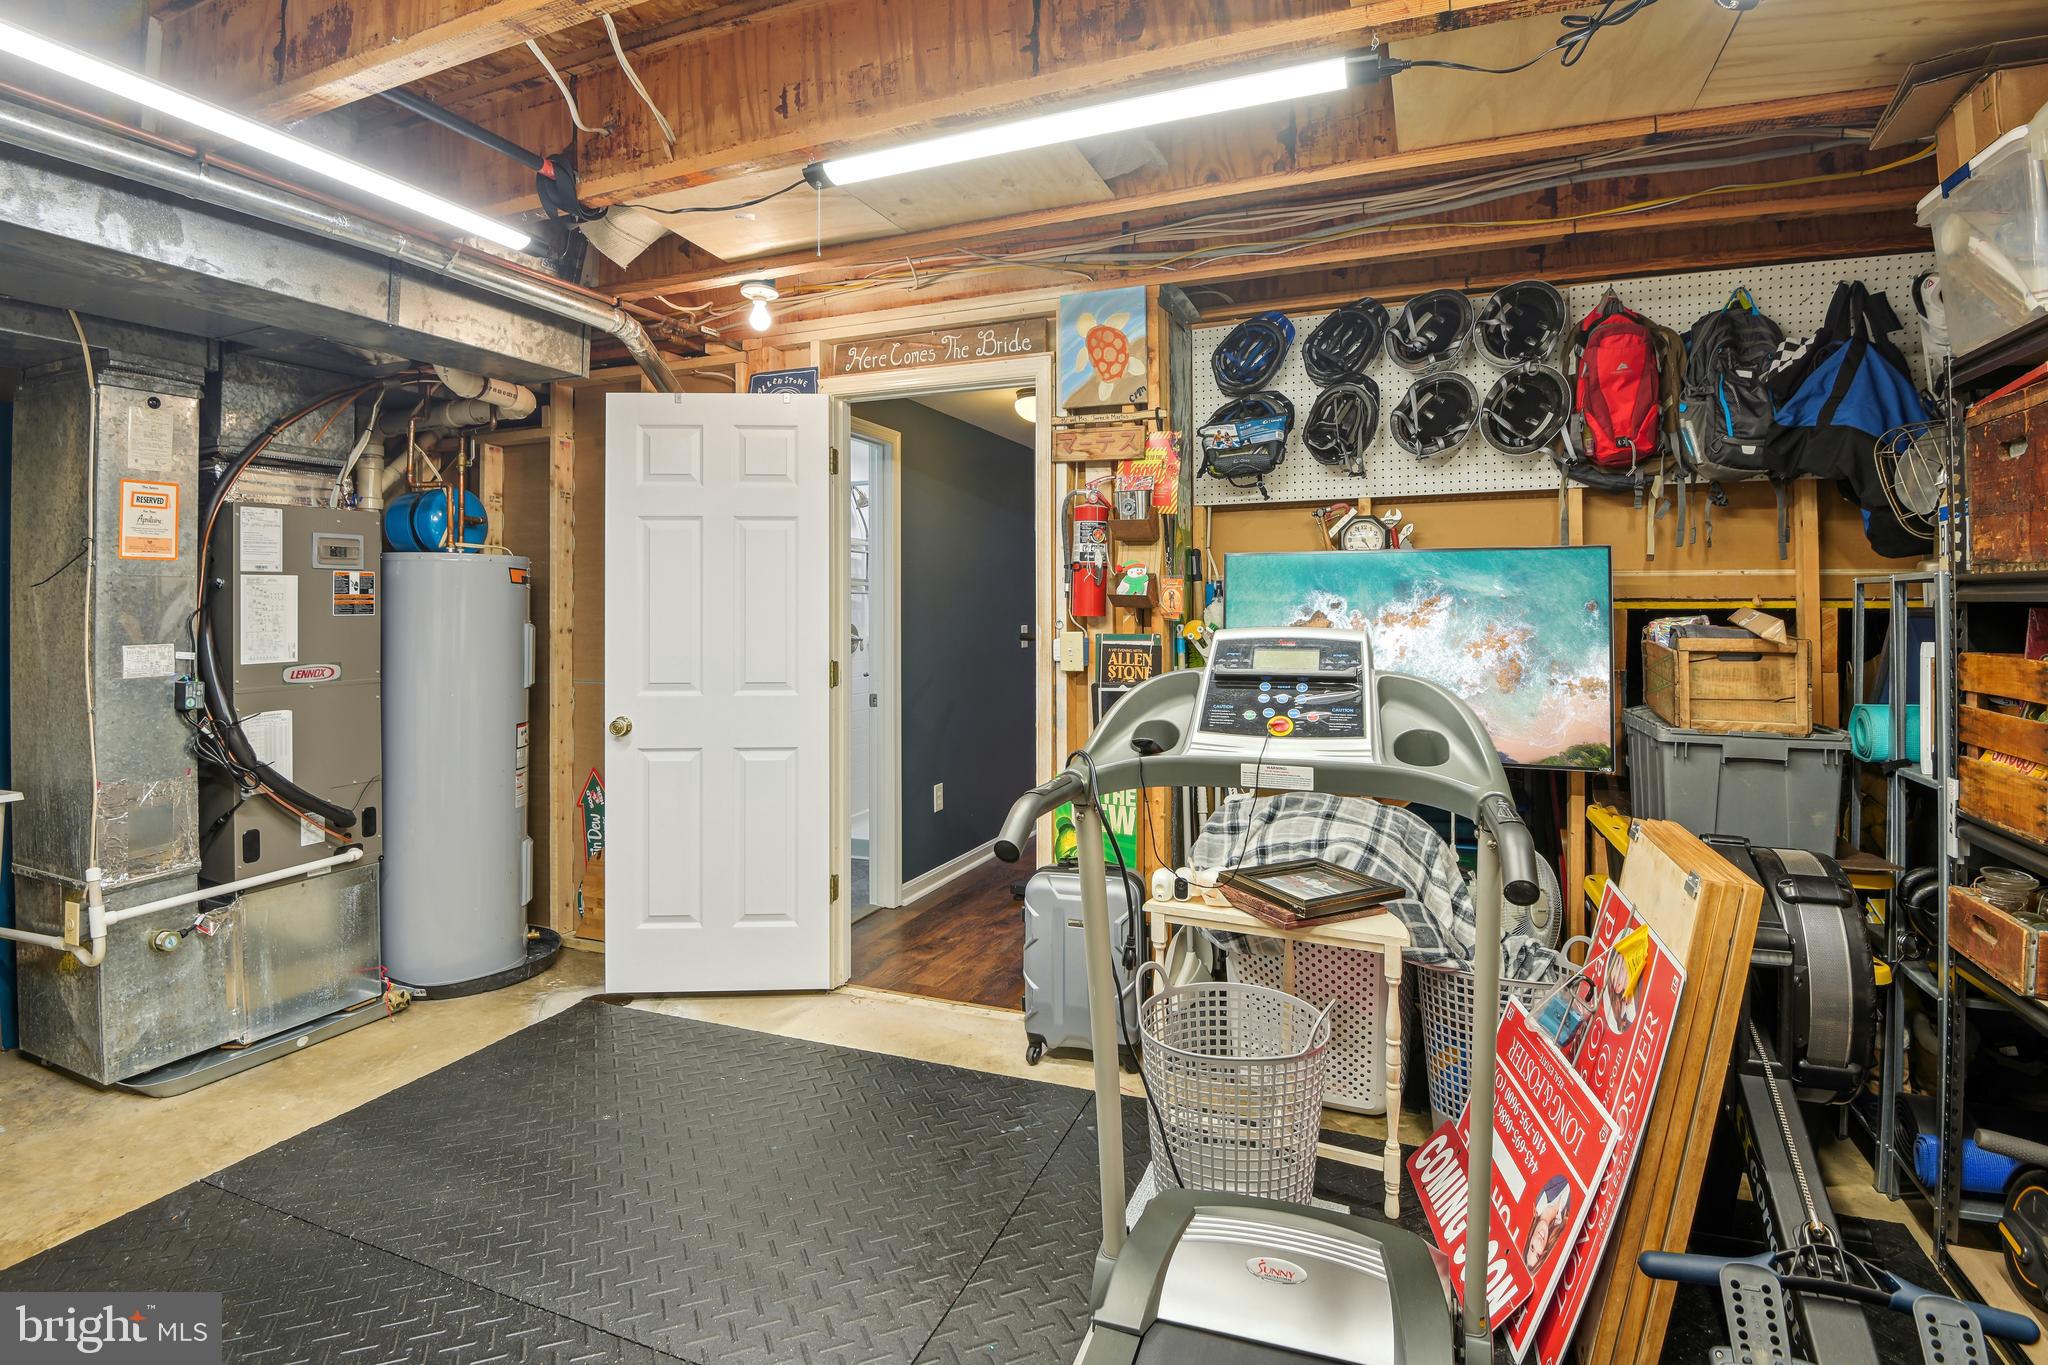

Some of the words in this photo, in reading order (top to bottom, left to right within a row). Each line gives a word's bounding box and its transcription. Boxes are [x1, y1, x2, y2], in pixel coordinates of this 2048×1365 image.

[845, 347, 887, 372] Here
[890, 343, 936, 368] Comes
[941, 334, 970, 360] The
[976, 328, 1032, 356] Bride
[757, 378, 783, 395] ALLEN
[1059, 432, 1139, 455] マーテス
[136, 495, 164, 505] RESERVED
[290, 667, 327, 680] LENNOX
[1108, 652, 1152, 666] ALLEN
[587, 813, 602, 843] Dew
[1508, 1036, 1547, 1099] FOSTER
[1539, 1053, 1554, 1076] ESTATE
[1554, 1070, 1565, 1090] REAL
[1612, 1010, 1660, 1162] OSTER
[1505, 1087, 1546, 1155] 410-795-9600
[1548, 1094, 1586, 1156] LONG
[1497, 1104, 1538, 1175] 443-695-0686
[1415, 1134, 1469, 1244] COMING
[1598, 1195, 1616, 1231] REAL
[1612, 1131, 1634, 1190] ESTATE
[1258, 1259, 1296, 1279] SUNNY
